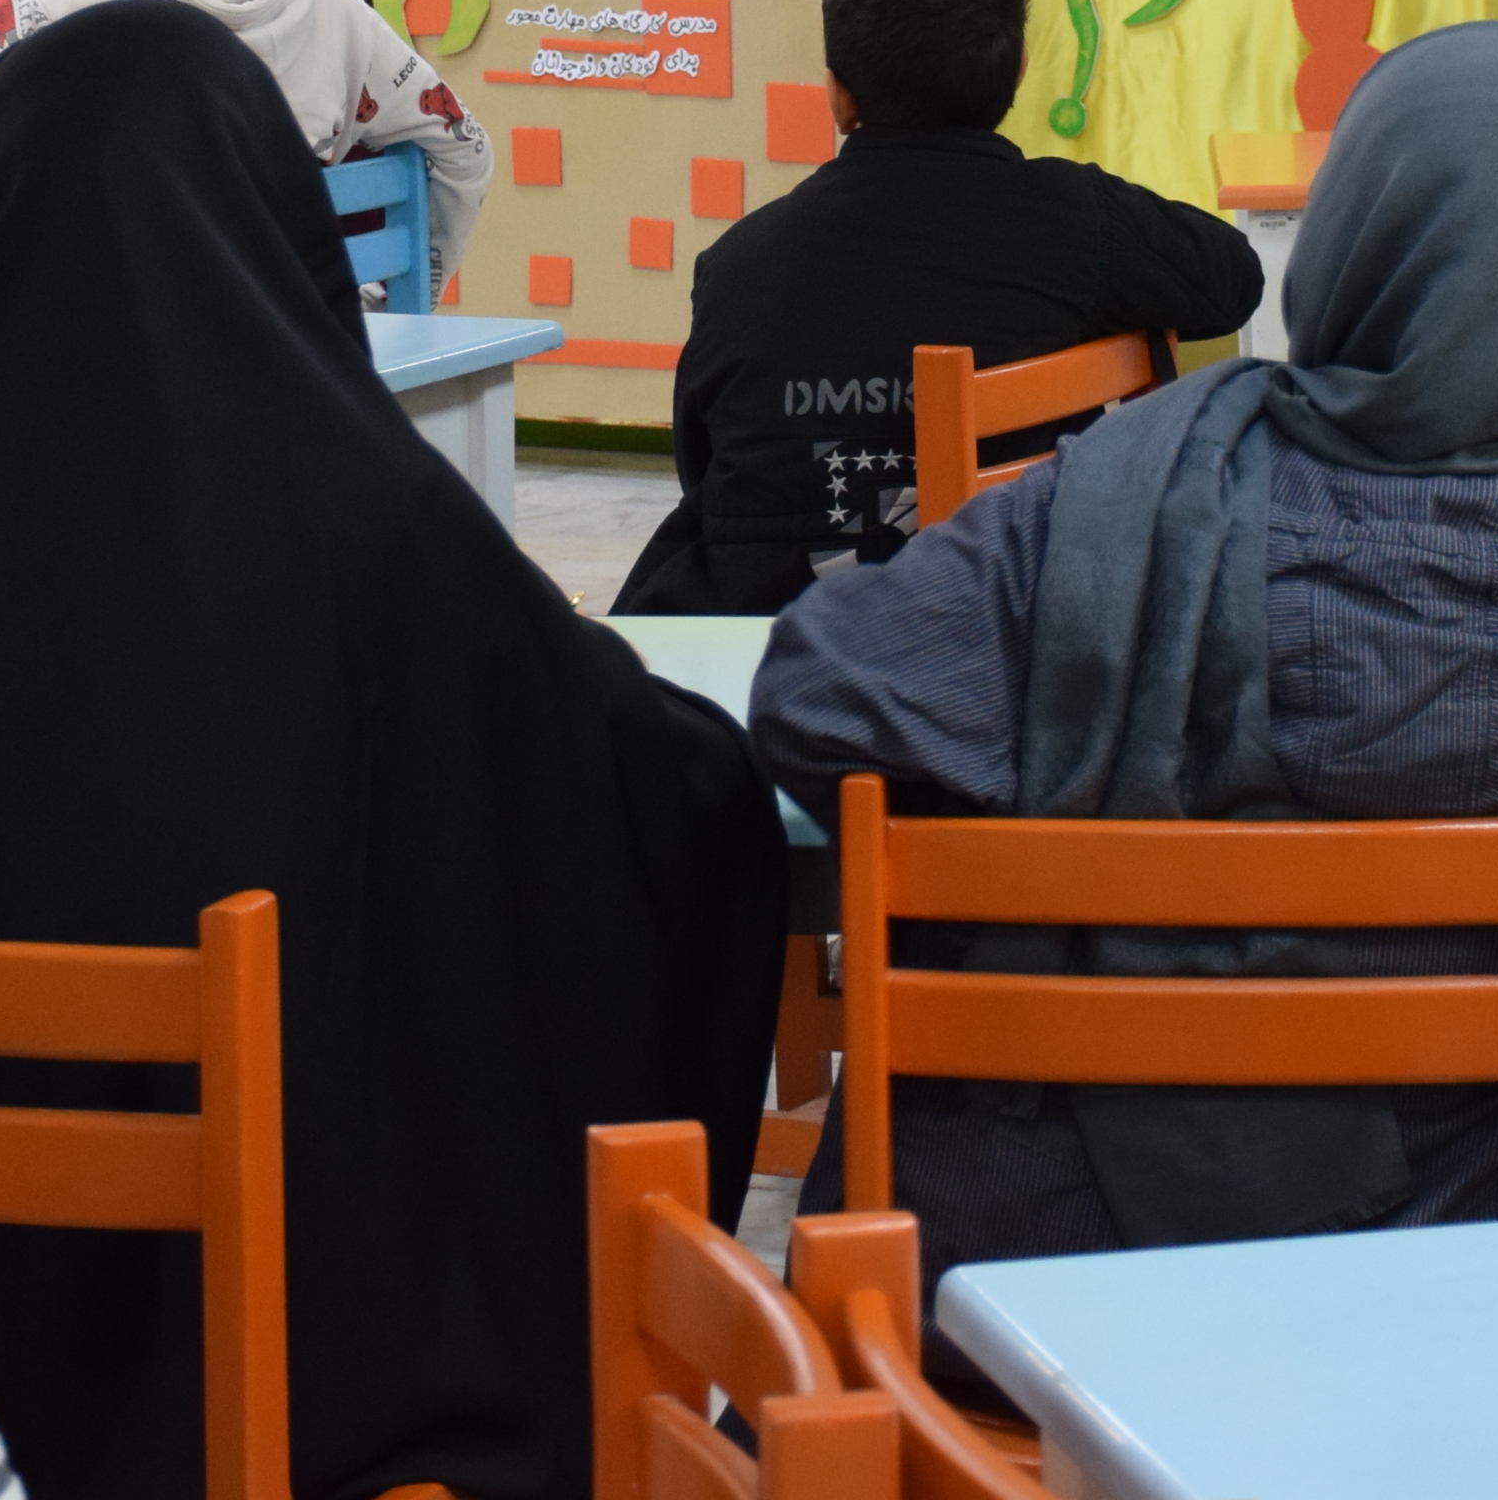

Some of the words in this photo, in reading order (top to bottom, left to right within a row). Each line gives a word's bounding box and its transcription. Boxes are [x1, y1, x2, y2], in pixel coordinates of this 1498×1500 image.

[507, 10, 541, 24] محور
[544, 7, 585, 31] مهارت
[670, 20, 716, 35] مدرس
[393, 56, 417, 88] LEGO
[532, 52, 594, 79] نوجوانان
[600, 59, 607, 75] و
[611, 54, 658, 77] کودکان
[664, 50, 699, 74] برای
